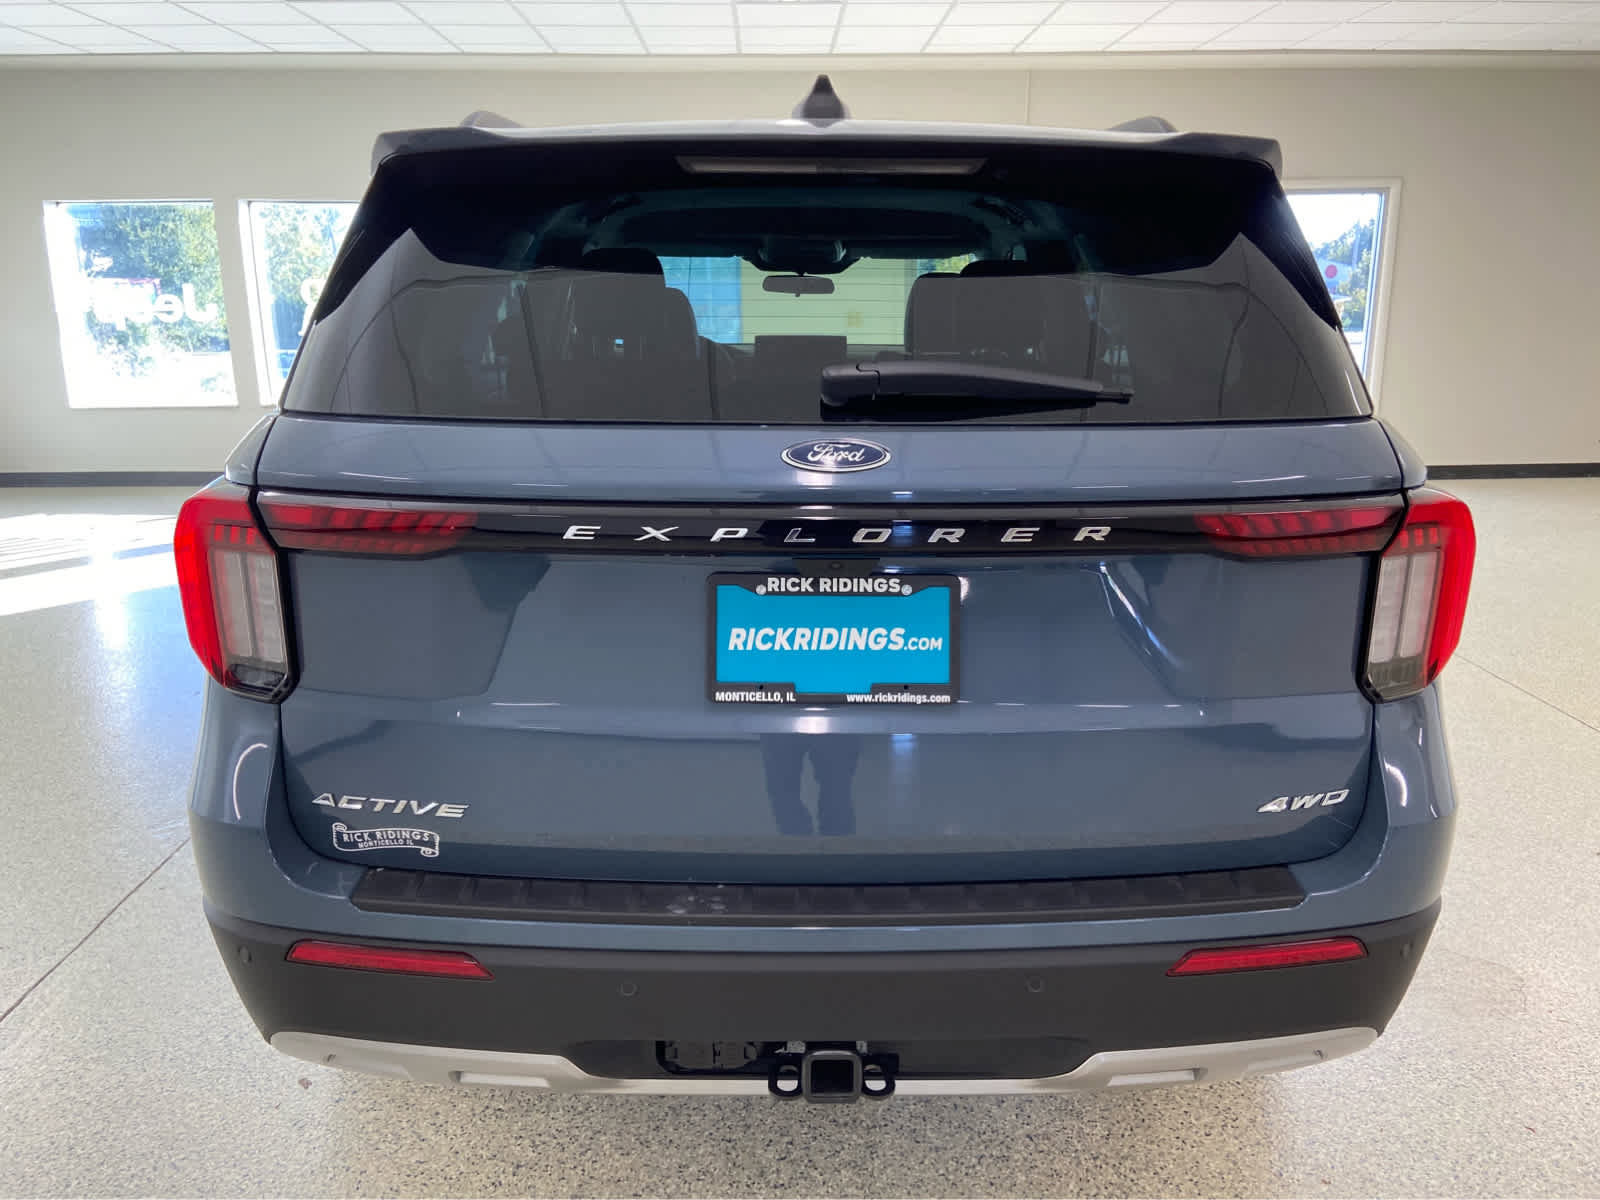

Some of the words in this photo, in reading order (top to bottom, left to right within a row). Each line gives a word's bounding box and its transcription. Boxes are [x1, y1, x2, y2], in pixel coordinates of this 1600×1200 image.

[807, 442, 865, 462] Ford
[562, 525, 1112, 543] EXPLORER
[767, 577, 815, 593] RICK
[819, 577, 901, 593] RIDINGS
[728, 627, 943, 651] RICKRIDINGS.COM
[715, 691, 784, 703] MONTICELLO,
[786, 692, 797, 702] IL
[846, 692, 951, 704] www.rickridings.com
[312, 792, 470, 818] ACTIVE
[1257, 789, 1350, 813] 4WD
[342, 831, 371, 843] RICK
[375, 830, 430, 842] RIDINGS
[358, 839, 404, 848] MONTICELLO
[406, 839, 414, 847] IL
